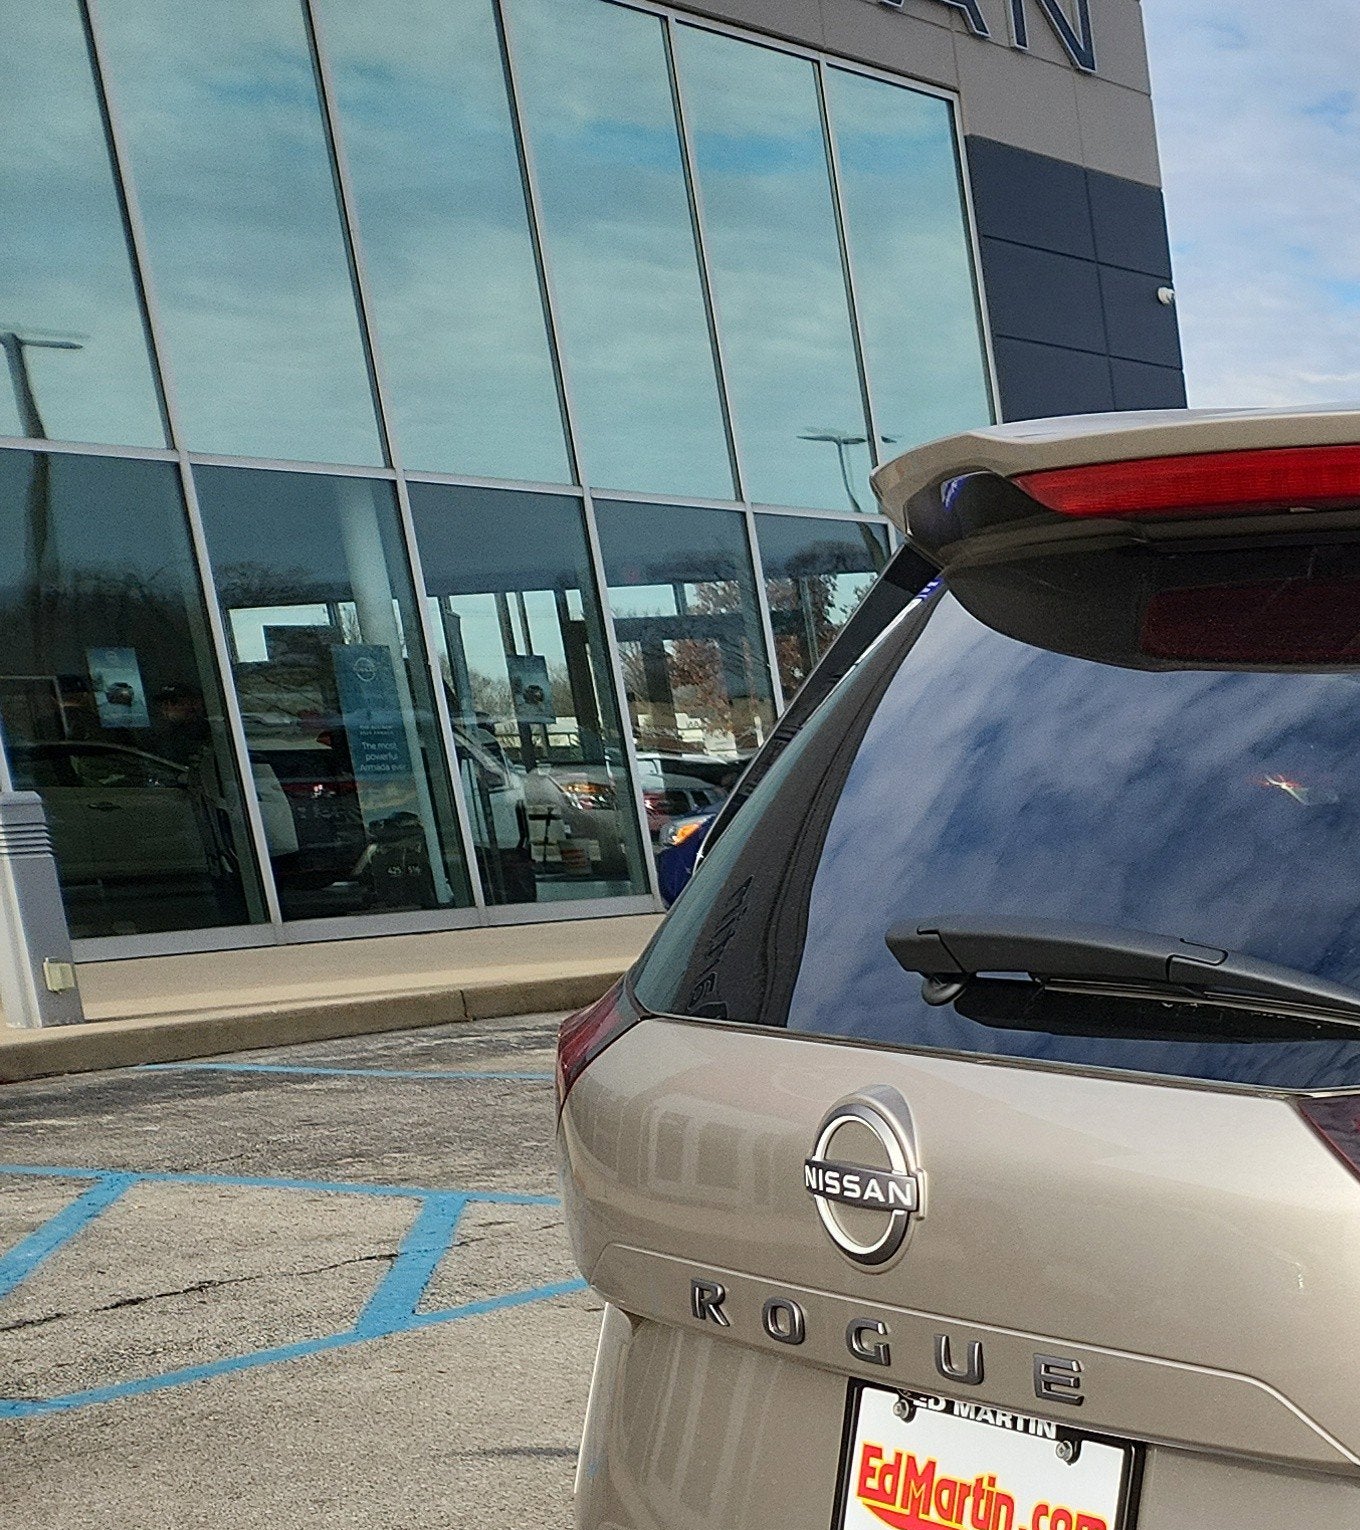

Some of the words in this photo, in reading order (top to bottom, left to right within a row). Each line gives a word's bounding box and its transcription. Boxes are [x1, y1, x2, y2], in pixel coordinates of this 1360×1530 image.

[804, 1164, 912, 1207] NISSAN
[690, 1277, 1085, 1406] ROGUE
[952, 1400, 1058, 1440] MARTIN
